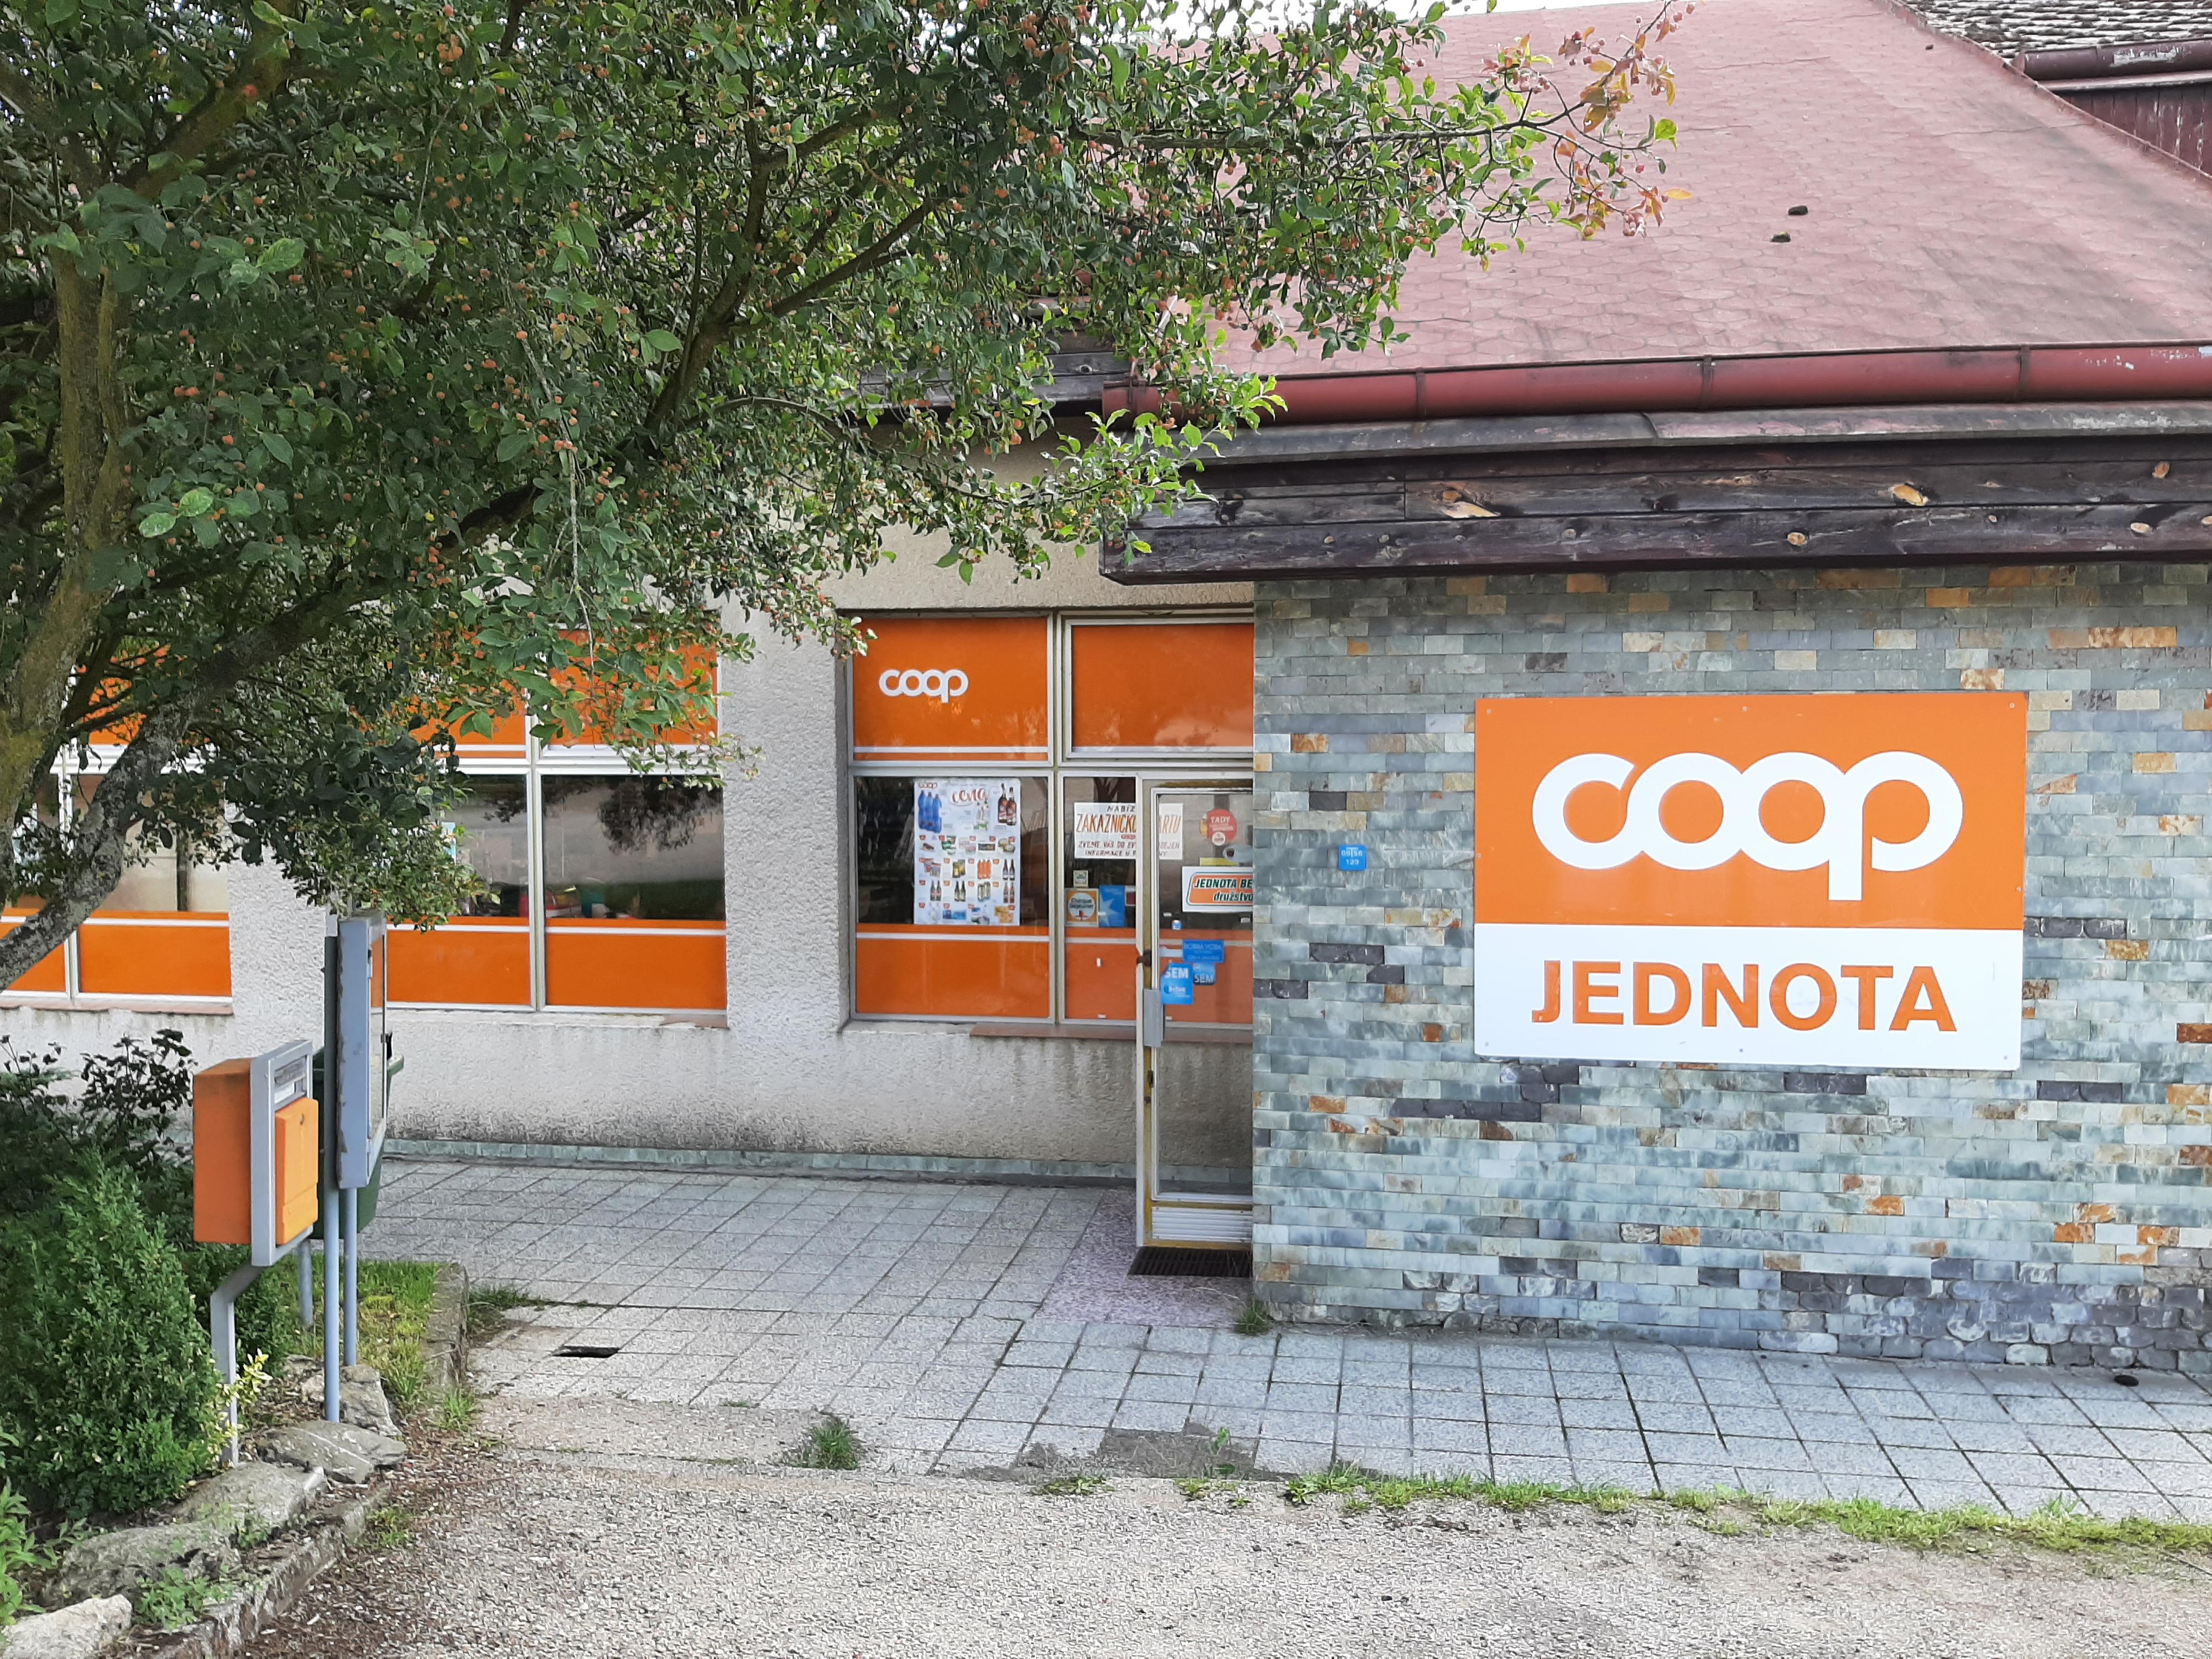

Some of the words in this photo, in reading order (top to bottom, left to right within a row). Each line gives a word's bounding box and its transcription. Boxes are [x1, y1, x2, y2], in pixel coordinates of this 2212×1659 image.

[879, 669, 968, 703] coop
[1532, 751, 1963, 901] coop
[1194, 879, 1237, 888] JEDNOTA
[1164, 967, 1188, 978] SEM
[1194, 974, 1213, 983] SEM
[1532, 960, 1957, 1032] JEDNOTA
